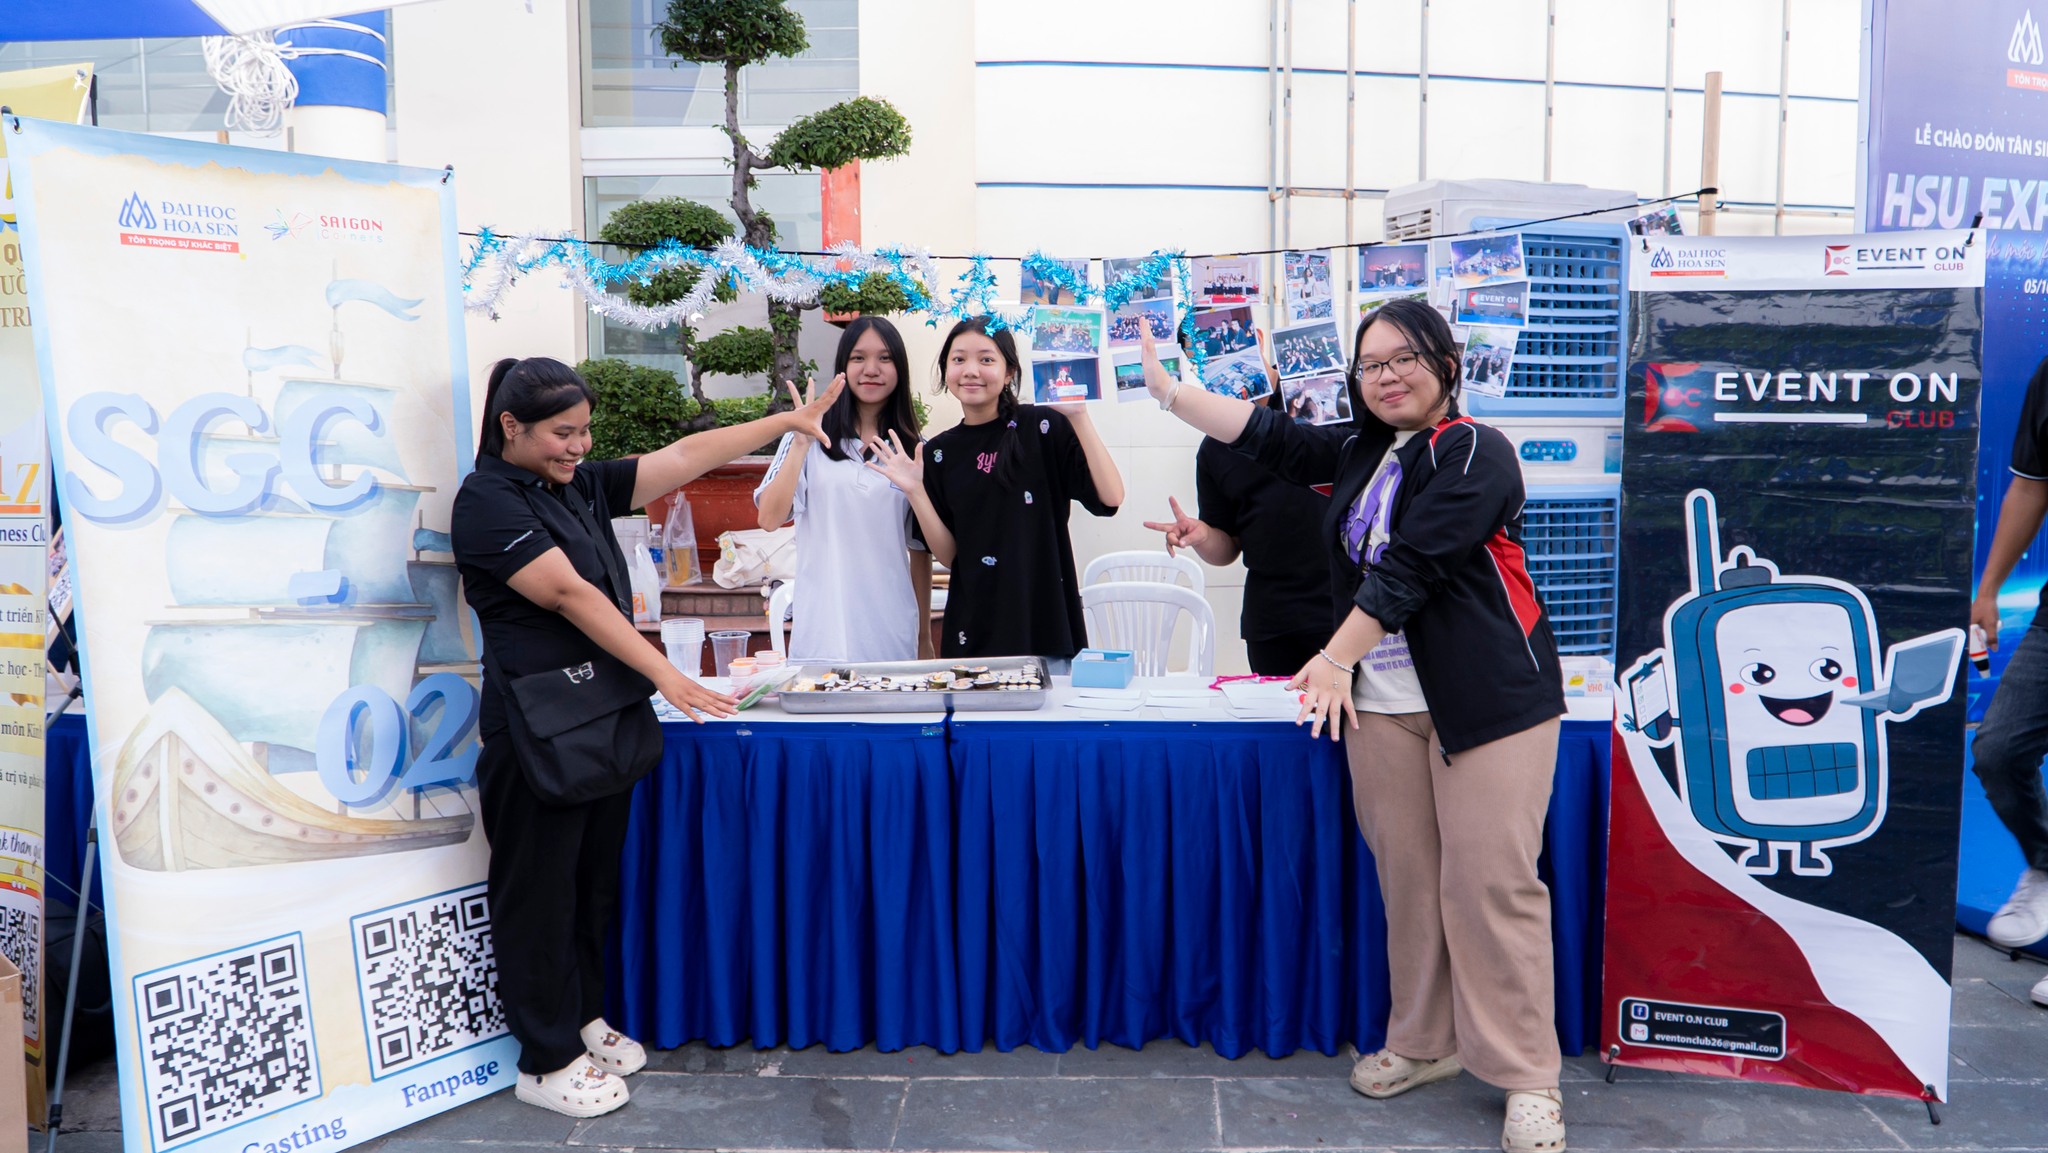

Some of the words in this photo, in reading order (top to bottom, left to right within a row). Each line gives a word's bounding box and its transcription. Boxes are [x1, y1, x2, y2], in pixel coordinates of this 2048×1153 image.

[1915, 122, 1932, 145] LỄ
[1934, 128, 1972, 150] CHÀO
[1974, 132, 2005, 152] ĐÓN
[2007, 134, 2032, 155] TÂN
[2035, 140, 2048, 157] SI
[1882, 173, 1969, 229] HSU
[164, 218, 204, 234] HOA
[206, 222, 239, 238] SEN
[320, 215, 383, 232] SAIGON
[1678, 259, 1702, 268] HOA
[1704, 259, 1726, 268] SEN
[1857, 247, 1927, 262] EVENT
[1935, 246, 1966, 261] ON
[1934, 262, 1964, 271] CLUB
[2024, 278, 2048, 294] 05/1
[1480, 294, 1505, 303] EVENT
[1507, 296, 1519, 304] ON
[1714, 371, 1870, 402] EVENT
[1889, 371, 1958, 402] ON
[1885, 409, 1955, 429] CLUB
[65, 390, 384, 528] SGC
[8, 660, 27, 679] học
[316, 672, 480, 814] 02
[1655, 1011, 1685, 1023] EVENT
[1704, 1016, 1729, 1028] CLUB
[1655, 1032, 1779, 1054] eventonclub26@gmail.com
[401, 1060, 499, 1108] Fanpage
